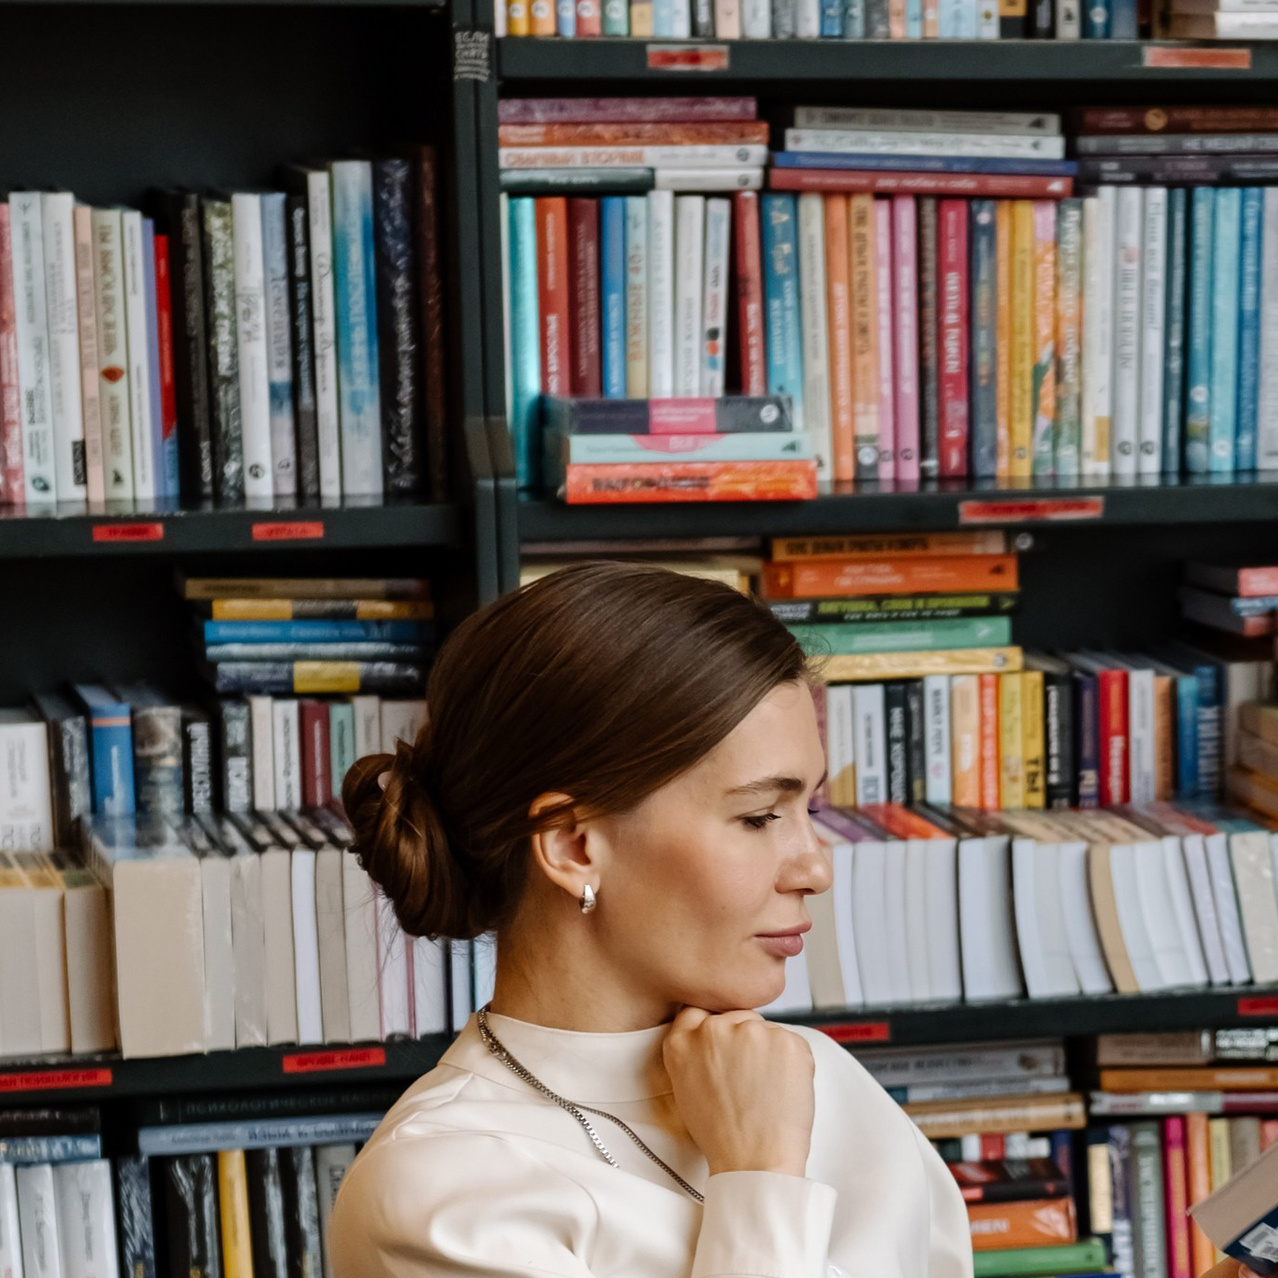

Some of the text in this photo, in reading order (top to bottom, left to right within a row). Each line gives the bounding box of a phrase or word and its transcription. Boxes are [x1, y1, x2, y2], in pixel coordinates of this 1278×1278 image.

[627, 283, 644, 362] ВАЖНЫЕ
[890, 706, 906, 804] МНЕ ХОРОШО
